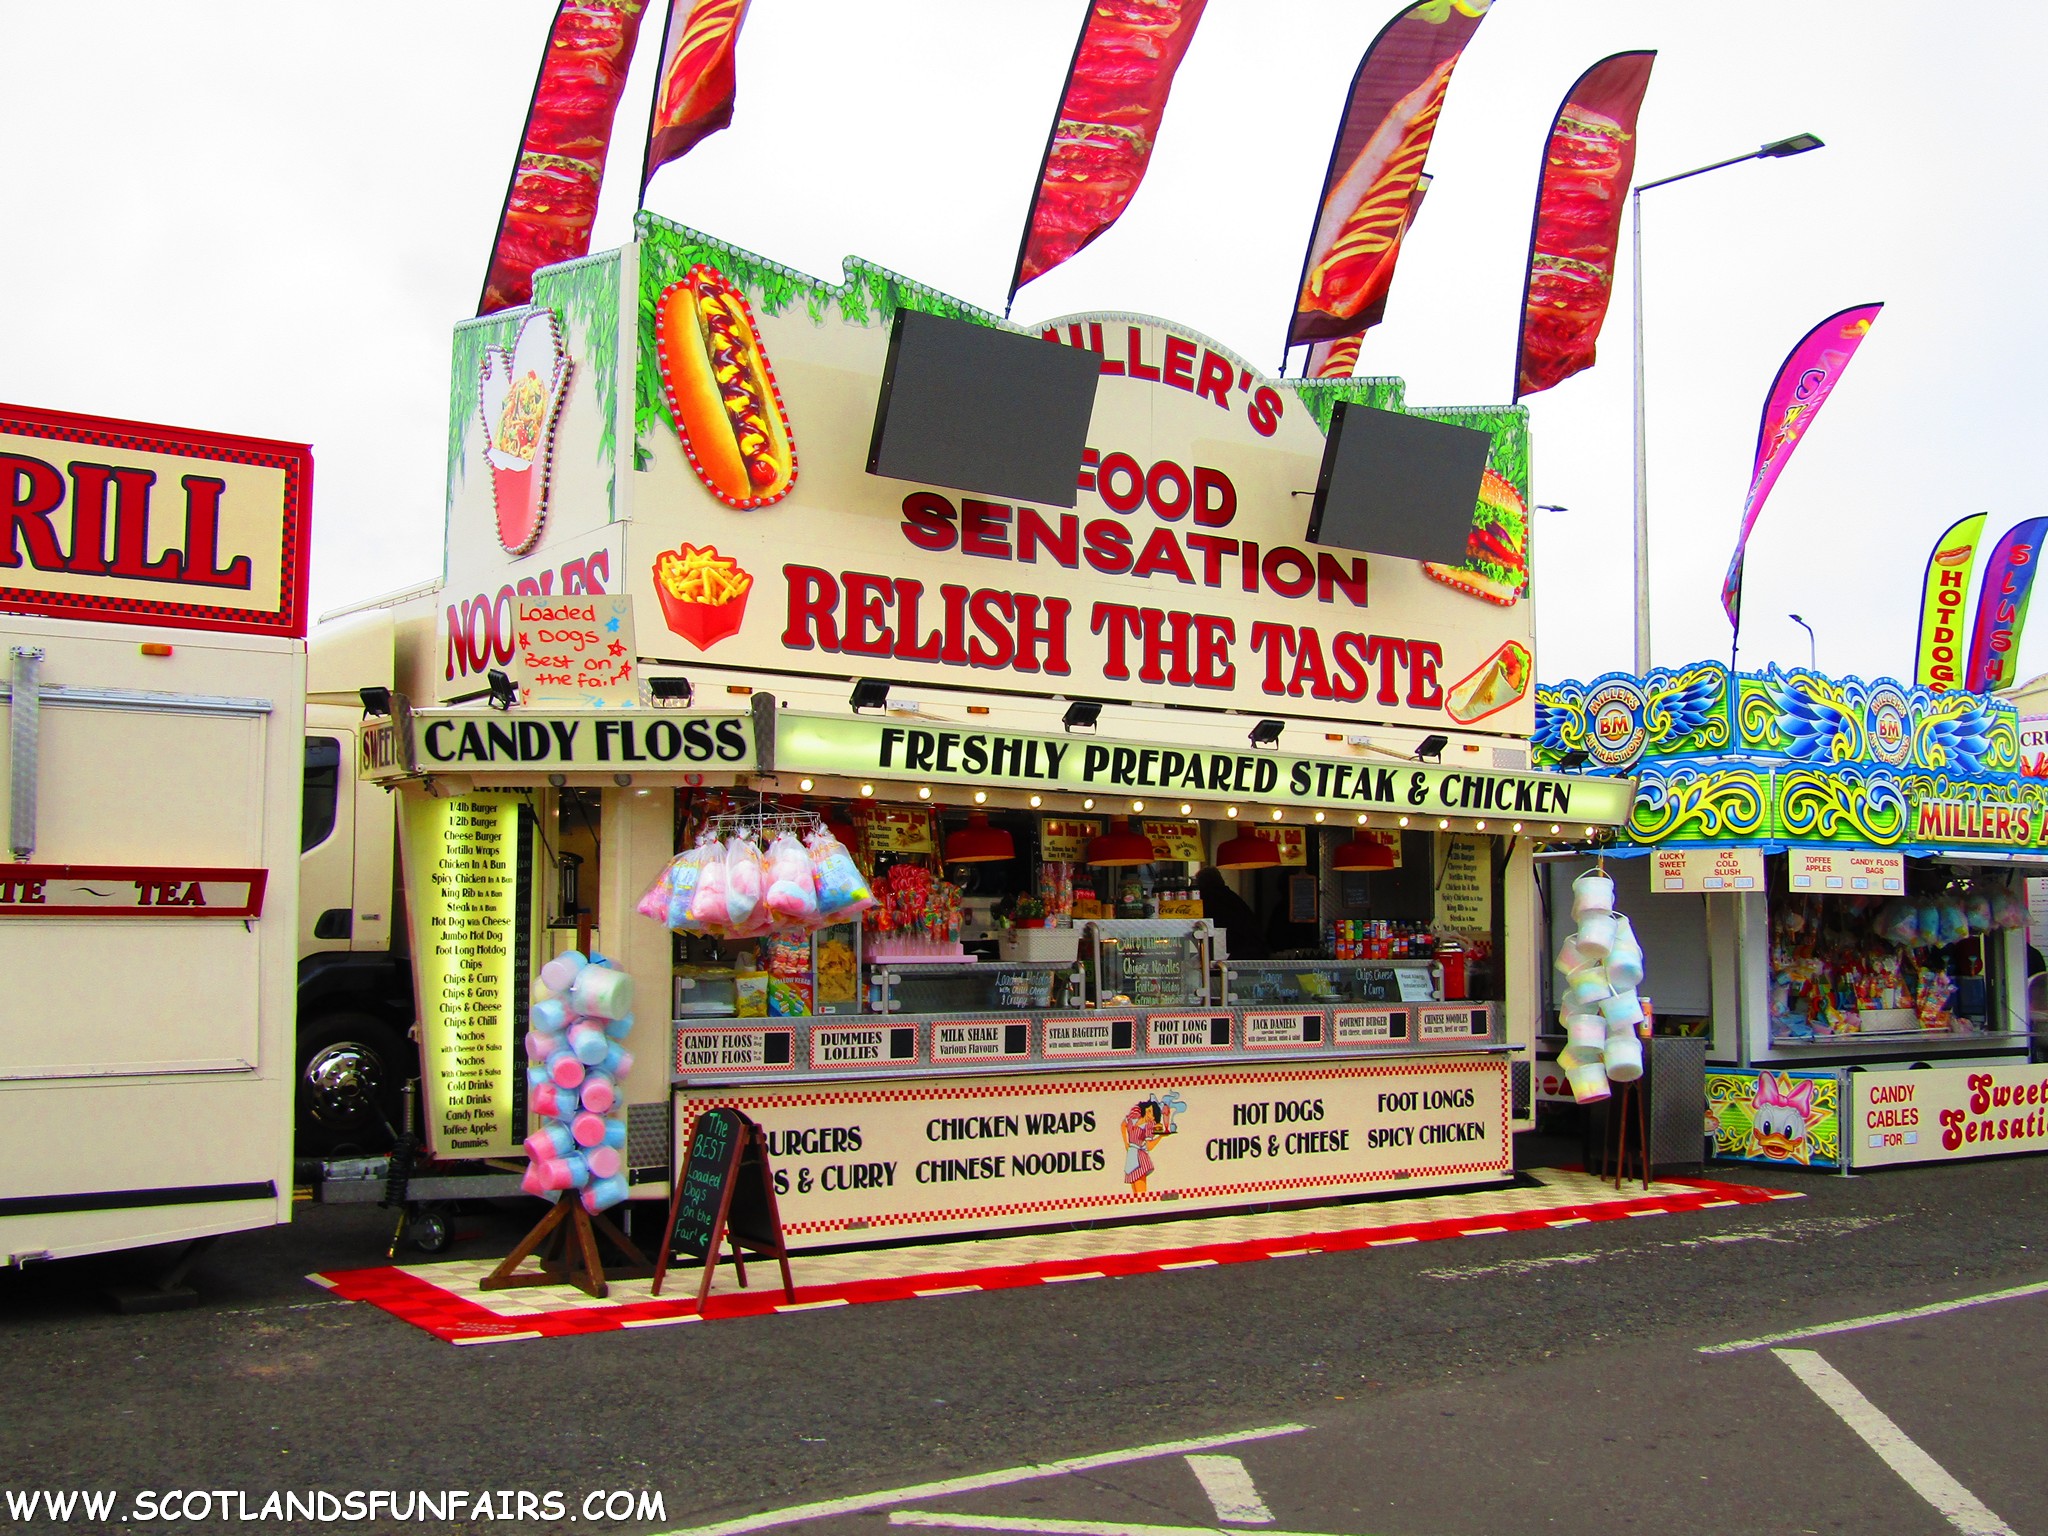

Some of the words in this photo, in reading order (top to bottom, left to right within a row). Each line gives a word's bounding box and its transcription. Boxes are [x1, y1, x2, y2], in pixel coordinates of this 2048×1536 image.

[901, 491, 1368, 608] SENSATION
[520, 603, 595, 622] Loaded
[1983, 543, 2034, 683] SLUSH
[782, 564, 1071, 675] RELISH
[1090, 600, 1237, 690] THE
[1251, 620, 1444, 710] TASTE
[525, 653, 575, 668] Best
[584, 658, 612, 670] on
[535, 673, 572, 686] the
[577, 673, 619, 688] fair
[1588, 688, 1640, 716] MILLER'S
[1871, 691, 1906, 718] MILLER'S
[1600, 716, 1629, 736] BM
[1879, 720, 1900, 740] BM
[424, 719, 580, 762] CANDY
[595, 719, 747, 762] FLOSS
[1585, 726, 1646, 762] ATTRACTIONS
[878, 727, 1070, 781] FRESHLY
[1083, 744, 1280, 795] PREPARED
[1290, 762, 1397, 803] STEAK
[1407, 771, 1431, 803] &
[1439, 774, 1572, 813] CHICKEN
[471, 803, 498, 814] Burger
[471, 817, 497, 828] Burger
[1917, 801, 2033, 847] MILLER'S
[444, 831, 474, 841] Cheese
[475, 831, 502, 842] Burger
[446, 845, 473, 855] Tortilla
[476, 846, 499, 856] Wraps
[439, 859, 469, 869] Chicken
[472, 860, 480, 868] In
[483, 860, 488, 868] A
[490, 860, 506, 869] Bun
[1805, 856, 1832, 864] TOFFEE
[1850, 858, 1874, 866] CANDY
[1876, 859, 1899, 867] FLOSS
[1714, 868, 1741, 876] SLUSH
[1865, 866, 1885, 874] BAGS
[431, 874, 453, 885] Spicy
[455, 874, 486, 883] Chicken
[135, 879, 206, 906] TEA
[442, 888, 460, 899] King
[462, 888, 476, 897] Rib
[447, 903, 470, 912] Steak
[431, 917, 446, 926] Hot
[449, 917, 465, 928] Dog
[482, 916, 511, 925] Cheese
[440, 931, 468, 941] Jumbo
[470, 931, 485, 940] Hot
[487, 931, 503, 942] Dog
[436, 945, 453, 955] Foot
[455, 945, 475, 957] Long
[477, 945, 506, 955] Hotdog
[460, 959, 483, 970] Chips
[443, 974, 466, 985] Chips
[468, 974, 474, 982] &
[477, 973, 498, 984] Curry
[442, 988, 465, 999] Chips
[468, 989, 473, 998] &
[476, 988, 499, 999] Gravy
[439, 1003, 461, 1014] Chips
[464, 1003, 470, 1012] &
[472, 1002, 502, 1012] Cheese
[444, 1018, 467, 1028] Chips
[469, 1017, 474, 1025] &
[477, 1016, 498, 1026] Chilli
[1154, 1021, 1180, 1032] FOOT
[1183, 1019, 1208, 1032] LONG
[1253, 1019, 1268, 1030] JACK
[1270, 1018, 1296, 1029] DANIELS
[1339, 1016, 1365, 1027] GOURMET
[1366, 1015, 1387, 1026] BURGER
[1424, 1014, 1444, 1024] CHINESE
[1446, 1013, 1468, 1023] NOODLES
[456, 1031, 485, 1041] Nachos
[821, 1031, 882, 1047] DUMMIES
[941, 1029, 964, 1042] MILK
[967, 1028, 998, 1041] SHAKE
[1049, 1028, 1070, 1039] STEAK
[1072, 1026, 1109, 1038] BAGUETTES
[1158, 1034, 1179, 1045] HOT
[1182, 1033, 1203, 1044] DOG
[685, 1036, 719, 1049] CANDY
[722, 1035, 752, 1048] FLOSS
[824, 1046, 879, 1060] LOLLIES
[940, 1046, 967, 1055] Various
[969, 1044, 999, 1054] Flavours
[456, 1056, 485, 1065] Nachos
[684, 1051, 719, 1065] CANDY
[722, 1050, 752, 1064] FLOSS
[448, 1081, 466, 1091] Cold
[468, 1080, 493, 1090] Drinks
[449, 1097, 464, 1105] Hot
[466, 1095, 491, 1104] Drinks
[1378, 1091, 1419, 1113] FOOT
[1424, 1089, 1474, 1111] LONGS
[1870, 1084, 1915, 1104] CANDY
[1968, 1074, 2048, 1115] Sweet
[446, 1110, 472, 1121] Candy
[474, 1108, 494, 1118] Floss
[1233, 1102, 1270, 1126] HOT
[1274, 1099, 1324, 1123] DOGS
[1867, 1108, 1918, 1128] CABLES
[443, 1125, 468, 1135] Toffee
[470, 1123, 498, 1134] Apples
[709, 1113, 729, 1137] The
[926, 1114, 1018, 1141] CHICKEN
[1025, 1111, 1097, 1137] WRAPS
[1939, 1107, 2048, 1151] Sensati
[1367, 1126, 1414, 1148] SPICY
[1420, 1122, 1485, 1144] CHICKEN
[1883, 1133, 1903, 1146] FOR
[451, 1138, 489, 1149] Dummies
[692, 1134, 726, 1162] BEST
[1206, 1135, 1263, 1162] CHIPS
[1267, 1134, 1280, 1156] &
[1285, 1130, 1349, 1155] CHEESE
[916, 1156, 1006, 1184] CHINESE
[1011, 1150, 1106, 1178] NOODLES
[688, 1161, 722, 1190] Loaded
[798, 1167, 814, 1193] &
[820, 1162, 899, 1192] CURRY
[684, 1181, 707, 1201] Dogs
[683, 1206, 695, 1218] on
[698, 1211, 712, 1226] the
